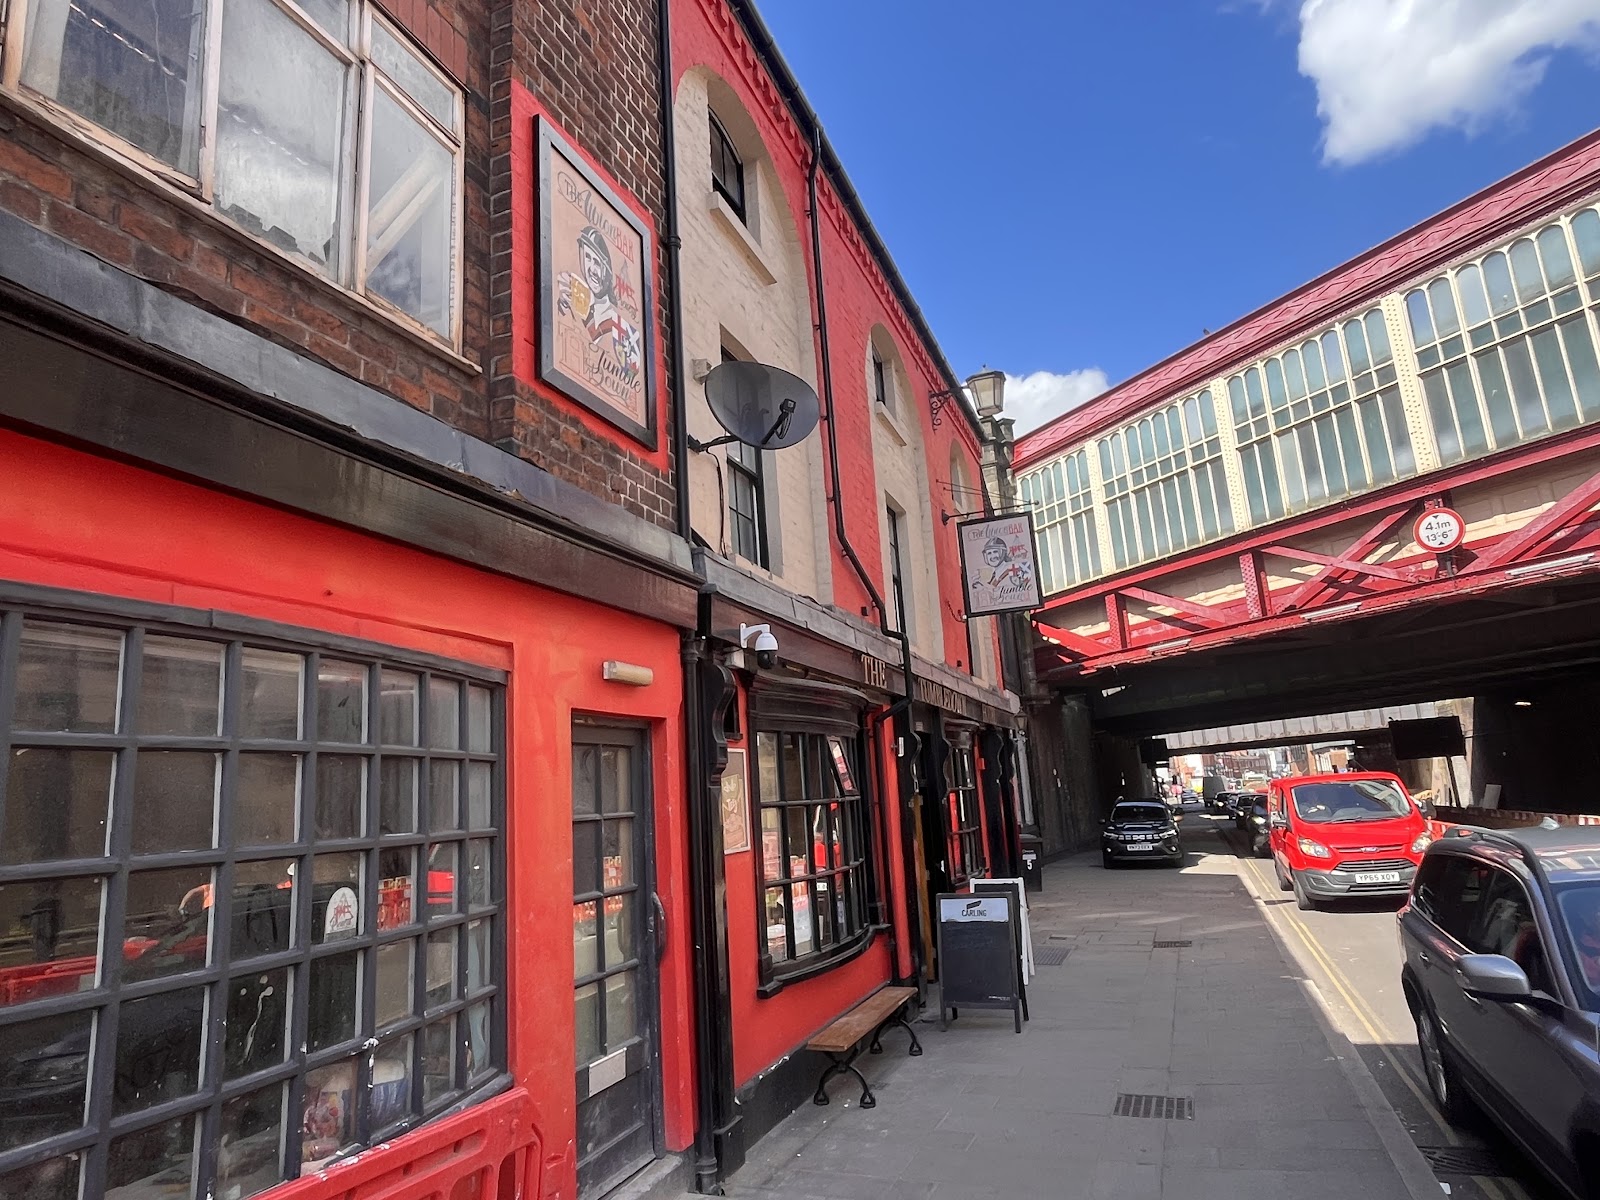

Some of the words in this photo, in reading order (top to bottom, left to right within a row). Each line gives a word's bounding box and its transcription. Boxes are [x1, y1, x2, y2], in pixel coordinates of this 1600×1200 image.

[564, 178, 582, 208] THE
[615, 226, 634, 259] BAR
[589, 342, 641, 393] Tumble
[1425, 521, 1451, 530] 4.1m
[861, 654, 887, 689] THE
[1026, 859, 1033, 870] 5
